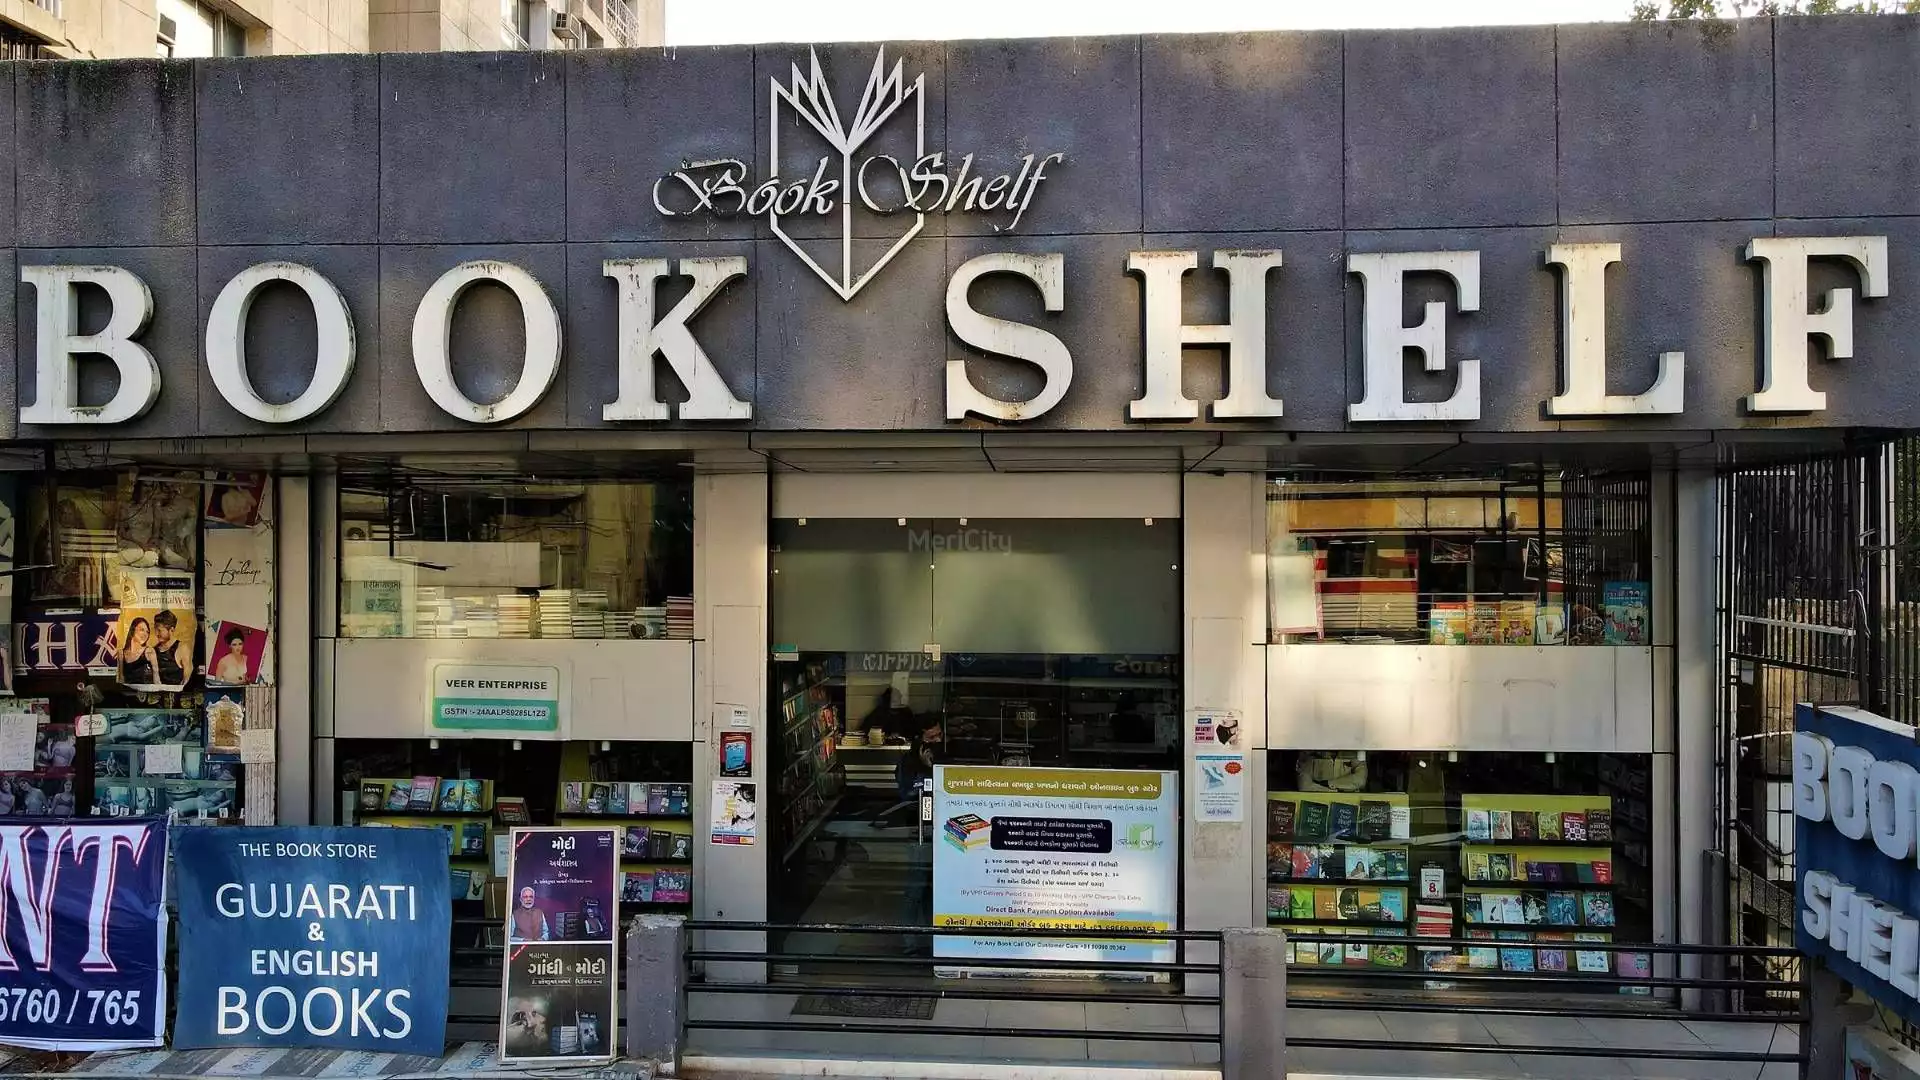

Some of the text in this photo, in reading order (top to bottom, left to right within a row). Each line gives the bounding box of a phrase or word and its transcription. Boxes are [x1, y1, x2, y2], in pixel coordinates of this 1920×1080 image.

[653, 151, 1065, 232] Book Shelf
[19, 235, 1889, 425] BOOK SHELF
[446, 680, 547, 690] VEER ENTERPRISE
[947, 779, 974, 788] ગુજરાતી
[1792, 731, 1920, 868] BOO
[239, 843, 377, 859] THE BOOK STORE
[552, 836, 575, 850] મોદી
[216, 882, 416, 920] GUJARATI
[986, 905, 1007, 913] Direct
[1083, 909, 1115, 917] Available
[308, 922, 325, 941] &
[1803, 870, 1920, 1002] SHEL
[251, 950, 378, 977] ENGLISH
[527, 958, 562, 975] ગાંધી
[575, 957, 606, 975] મોદી
[66, 989, 78, 1024] /
[88, 989, 141, 1026] 765
[217, 986, 412, 1039] BOOKS
